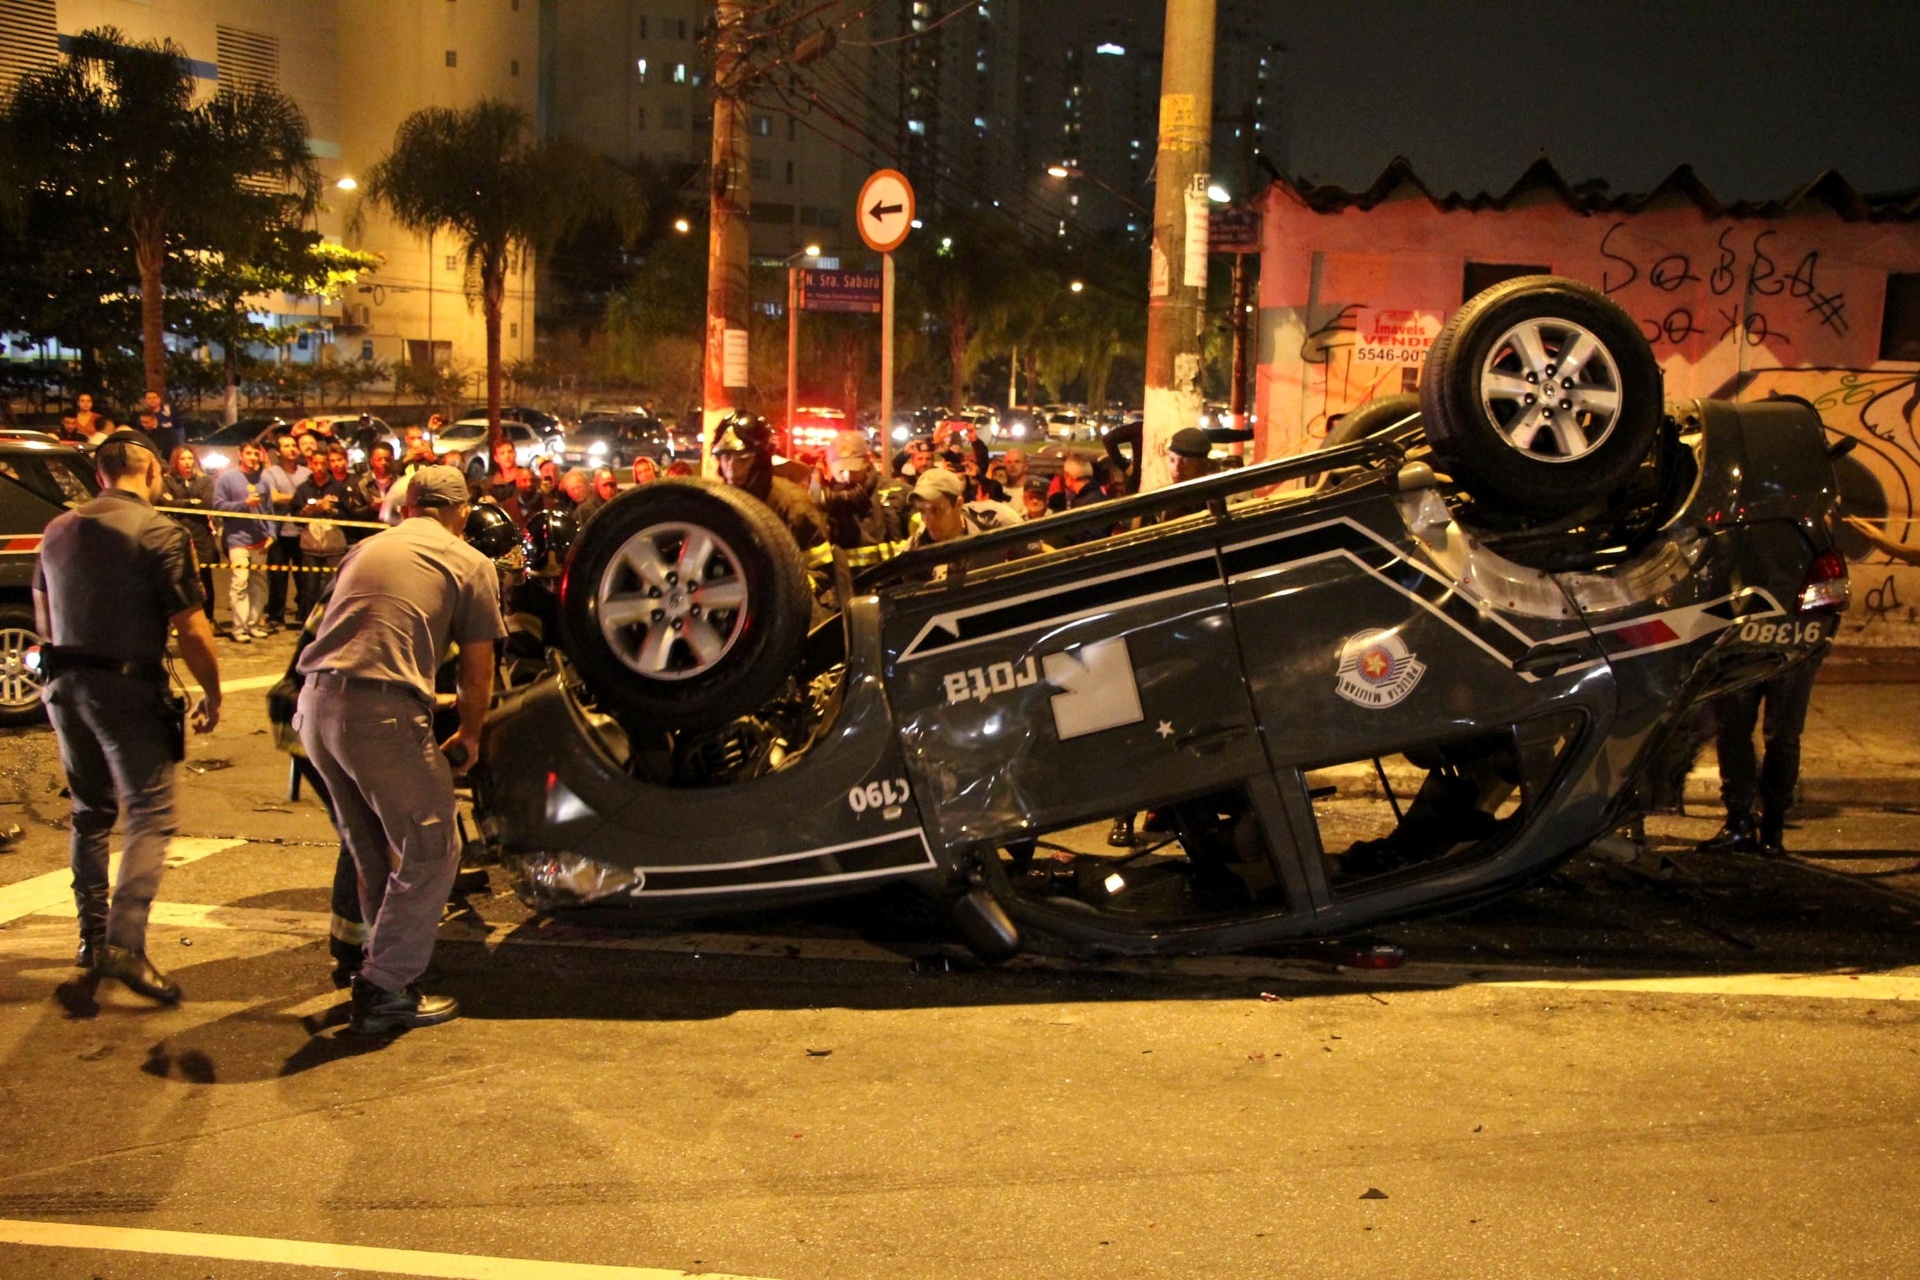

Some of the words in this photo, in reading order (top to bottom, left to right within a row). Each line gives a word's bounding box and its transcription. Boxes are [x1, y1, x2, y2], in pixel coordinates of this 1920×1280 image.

[806, 273, 816, 286] N.
[820, 274, 839, 287] Sra.
[843, 274, 880, 289] Sabará
[1740, 621, 1821, 644] 91380
[943, 655, 1038, 703] rota
[1343, 681, 1382, 703] MILITAR
[849, 777, 911, 812] C190
